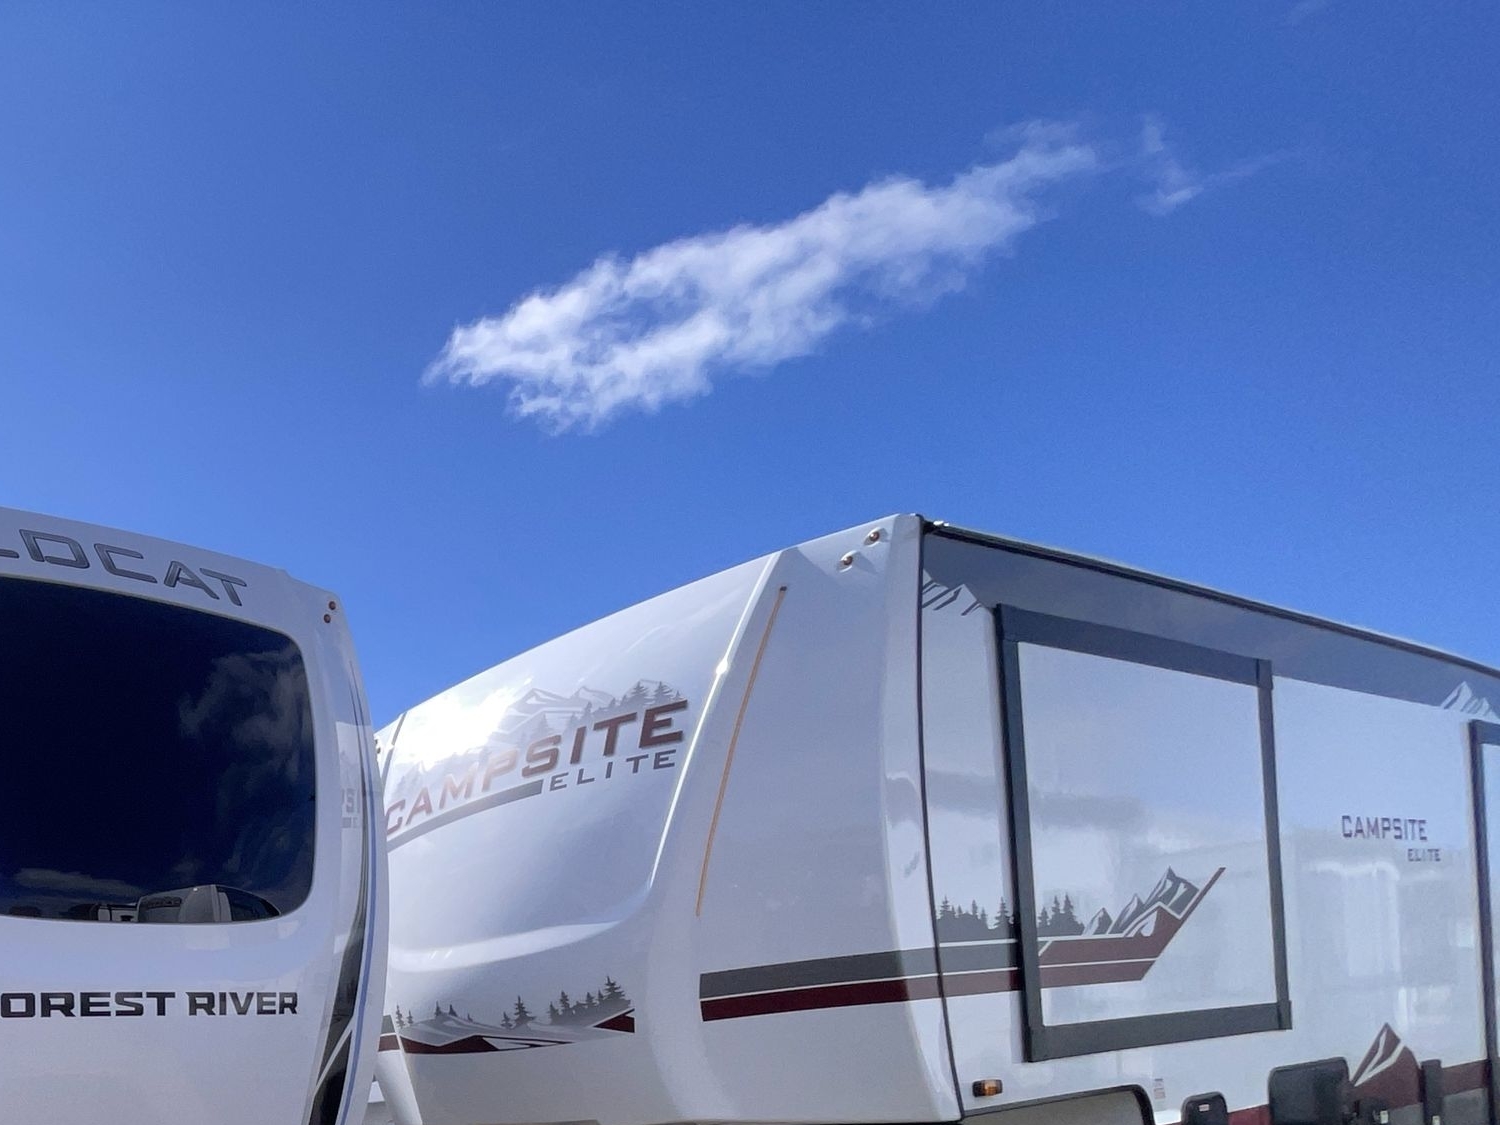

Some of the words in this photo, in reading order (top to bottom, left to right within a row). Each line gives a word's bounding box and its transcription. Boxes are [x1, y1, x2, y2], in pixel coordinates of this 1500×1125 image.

[386, 699, 688, 836] CAMPSITE
[549, 749, 677, 792] ELITE
[1342, 815, 1428, 841] CAMPSITE
[1407, 848, 1441, 862] ELITE
[186, 990, 298, 1016] RIVER
